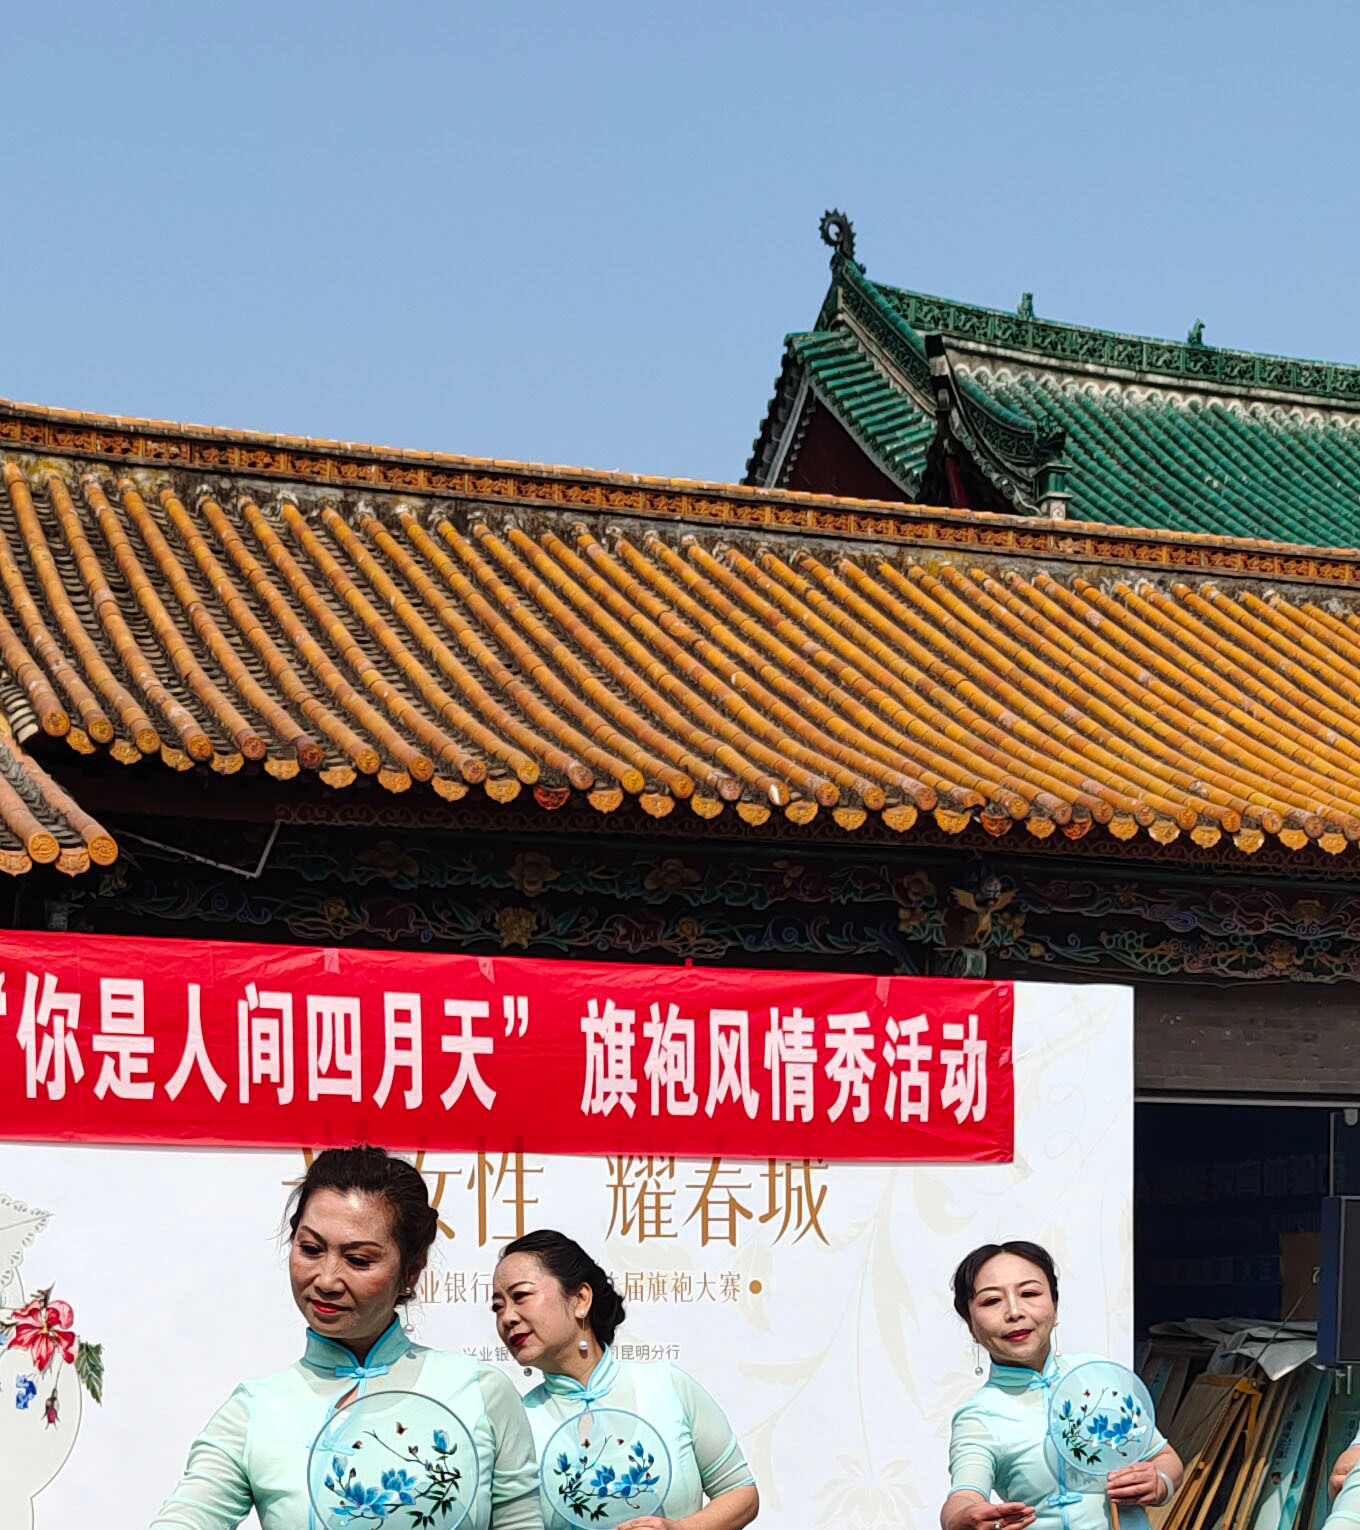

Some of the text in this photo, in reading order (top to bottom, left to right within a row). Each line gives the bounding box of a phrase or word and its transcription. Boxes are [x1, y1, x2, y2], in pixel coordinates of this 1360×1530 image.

[579, 997, 989, 1125] 旗袍风情秀活动
[604, 1155, 832, 1248] 耀春城
[607, 1271, 741, 1304] 届旗袍大赛
